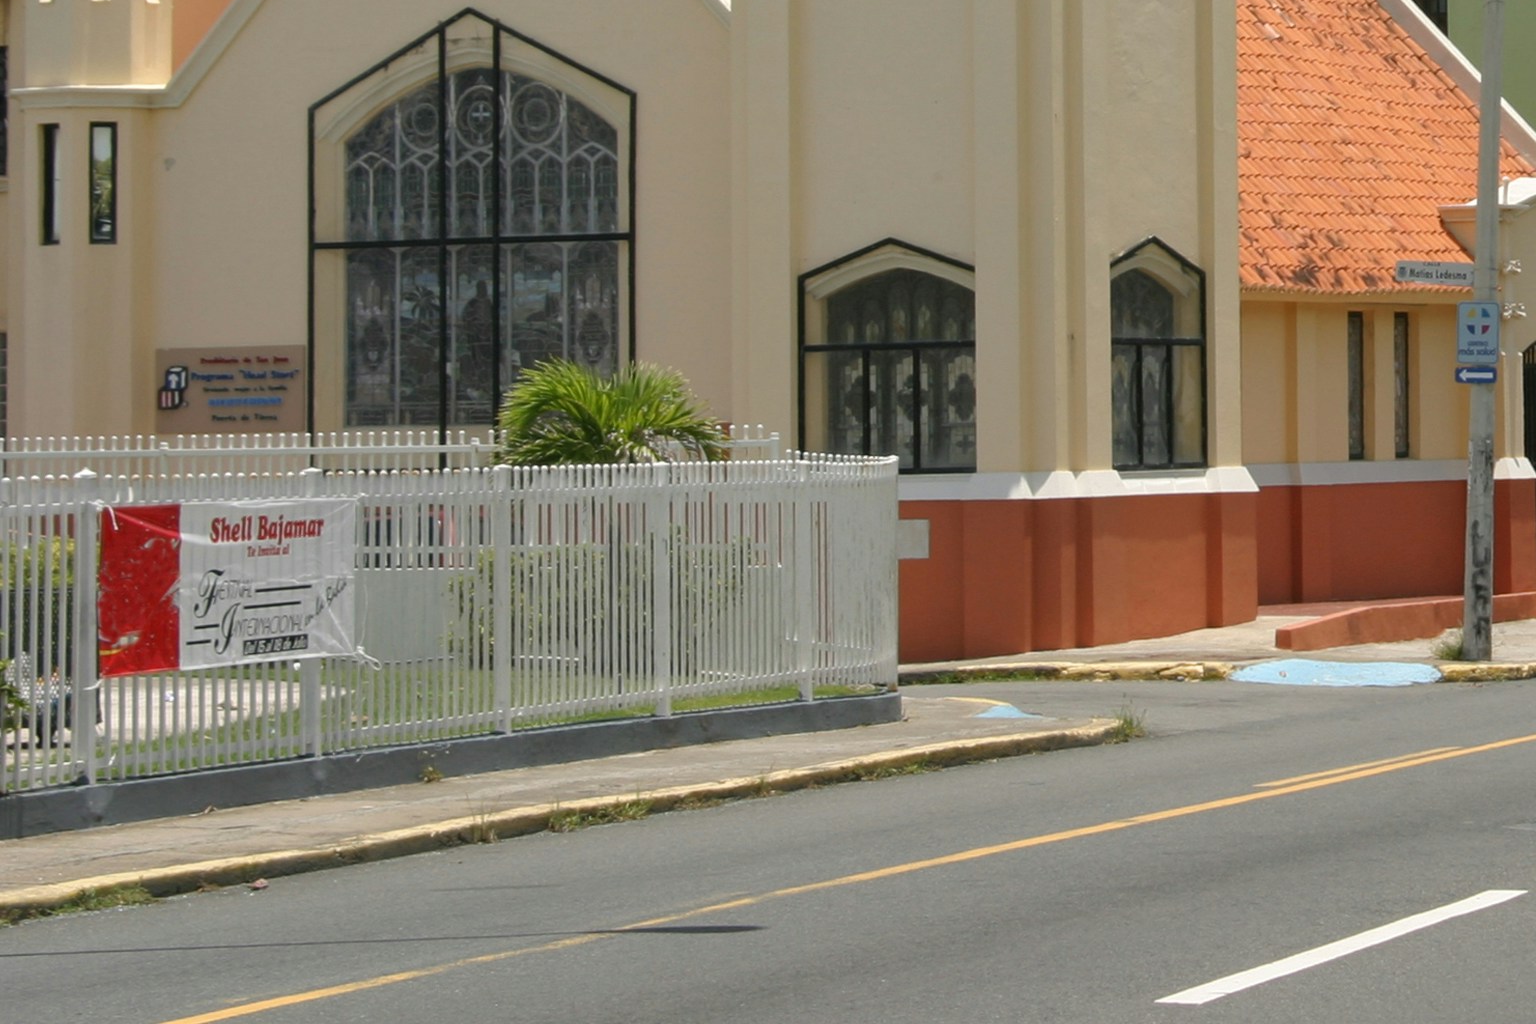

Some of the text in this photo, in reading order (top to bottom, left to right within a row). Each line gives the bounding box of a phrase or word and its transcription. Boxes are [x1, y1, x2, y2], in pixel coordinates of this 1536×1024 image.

[1435, 269, 1467, 280] Ledesma
[191, 371, 234, 382] Programa
[210, 514, 324, 545] Shell Bajamar
